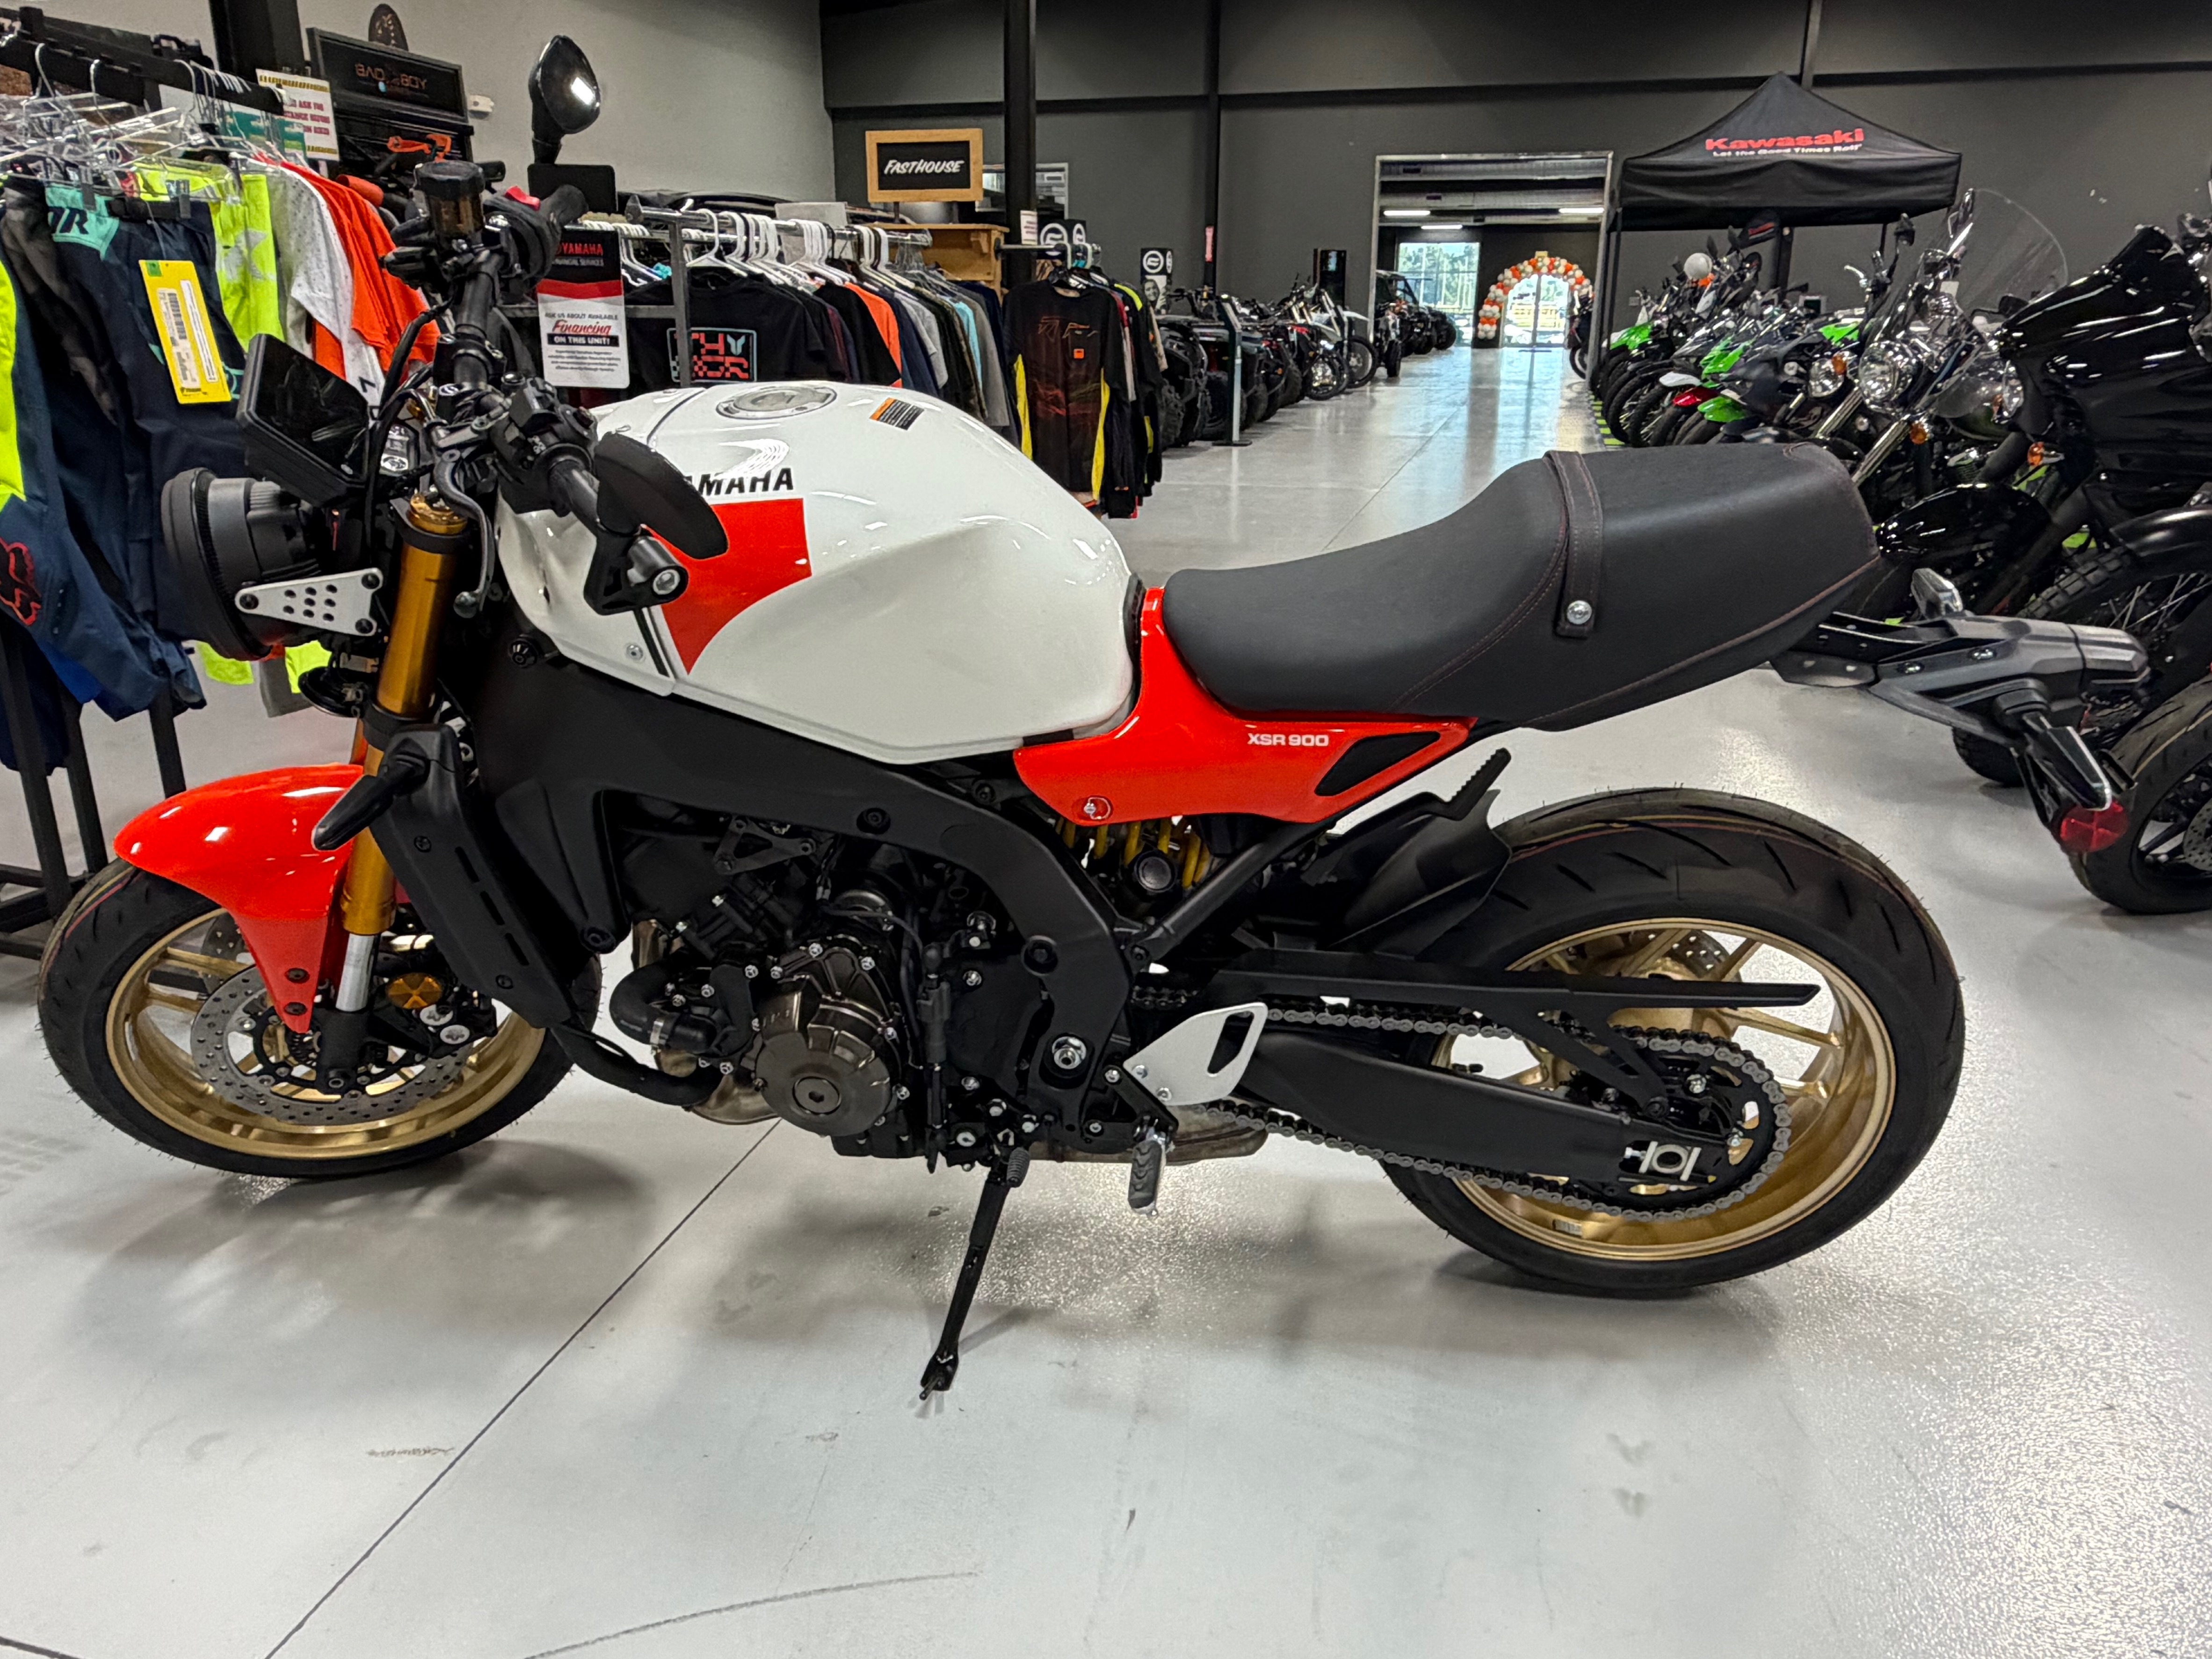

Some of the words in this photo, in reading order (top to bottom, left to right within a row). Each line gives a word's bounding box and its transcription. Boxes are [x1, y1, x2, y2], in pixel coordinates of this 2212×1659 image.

[355, 63, 385, 80] BAD
[400, 73, 428, 89] BOY
[1705, 128, 1864, 150] Kawasaki
[884, 159, 965, 175] FASTHOUSE
[561, 242, 603, 256] YAMAHA
[552, 319, 612, 335] Financing
[684, 468, 794, 496] MAHA
[1247, 733, 1286, 746] XSR
[1289, 734, 1329, 747] 900
